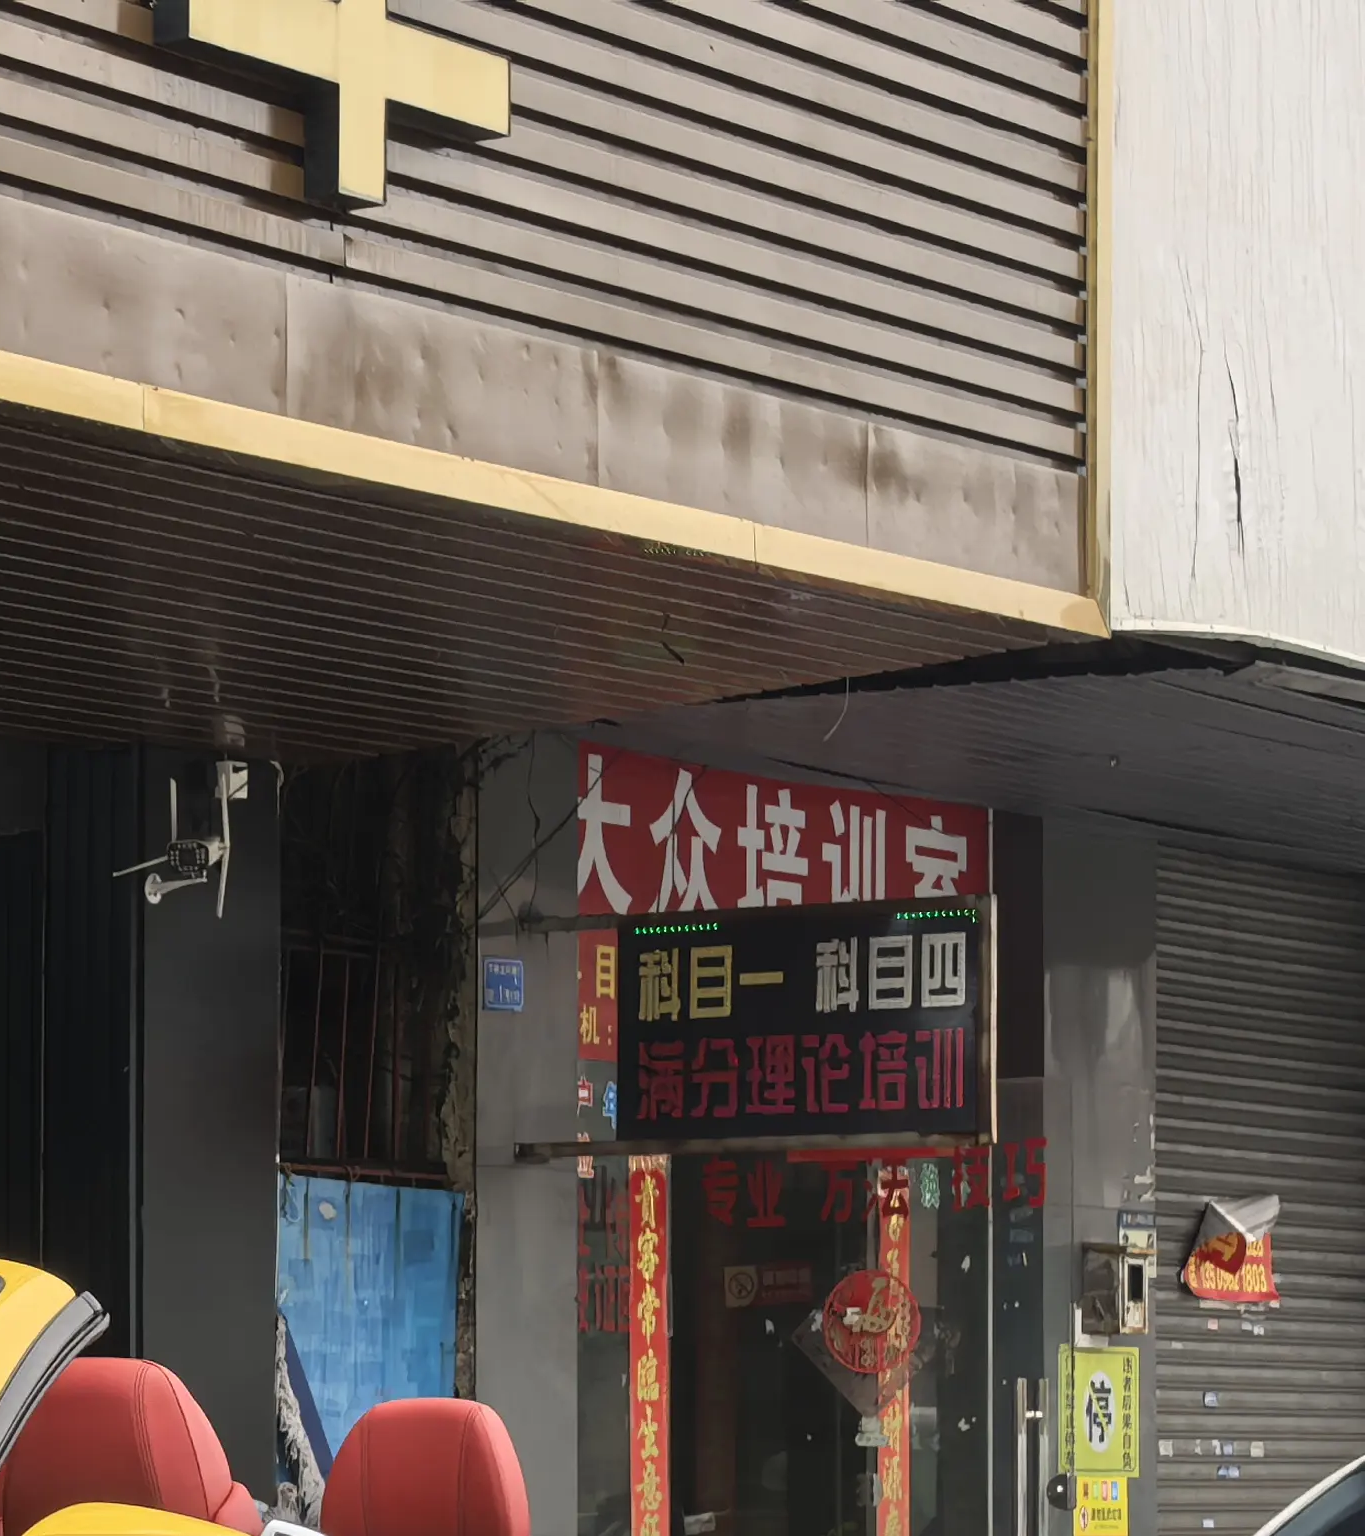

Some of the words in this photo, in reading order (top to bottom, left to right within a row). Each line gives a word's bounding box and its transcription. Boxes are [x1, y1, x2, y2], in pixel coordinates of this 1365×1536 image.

[638, 944, 784, 1022] 科目一
[815, 931, 967, 1013] 科目四
[635, 1026, 966, 1121] 满分理论培训
[951, 1137, 1048, 1213] 技巧
